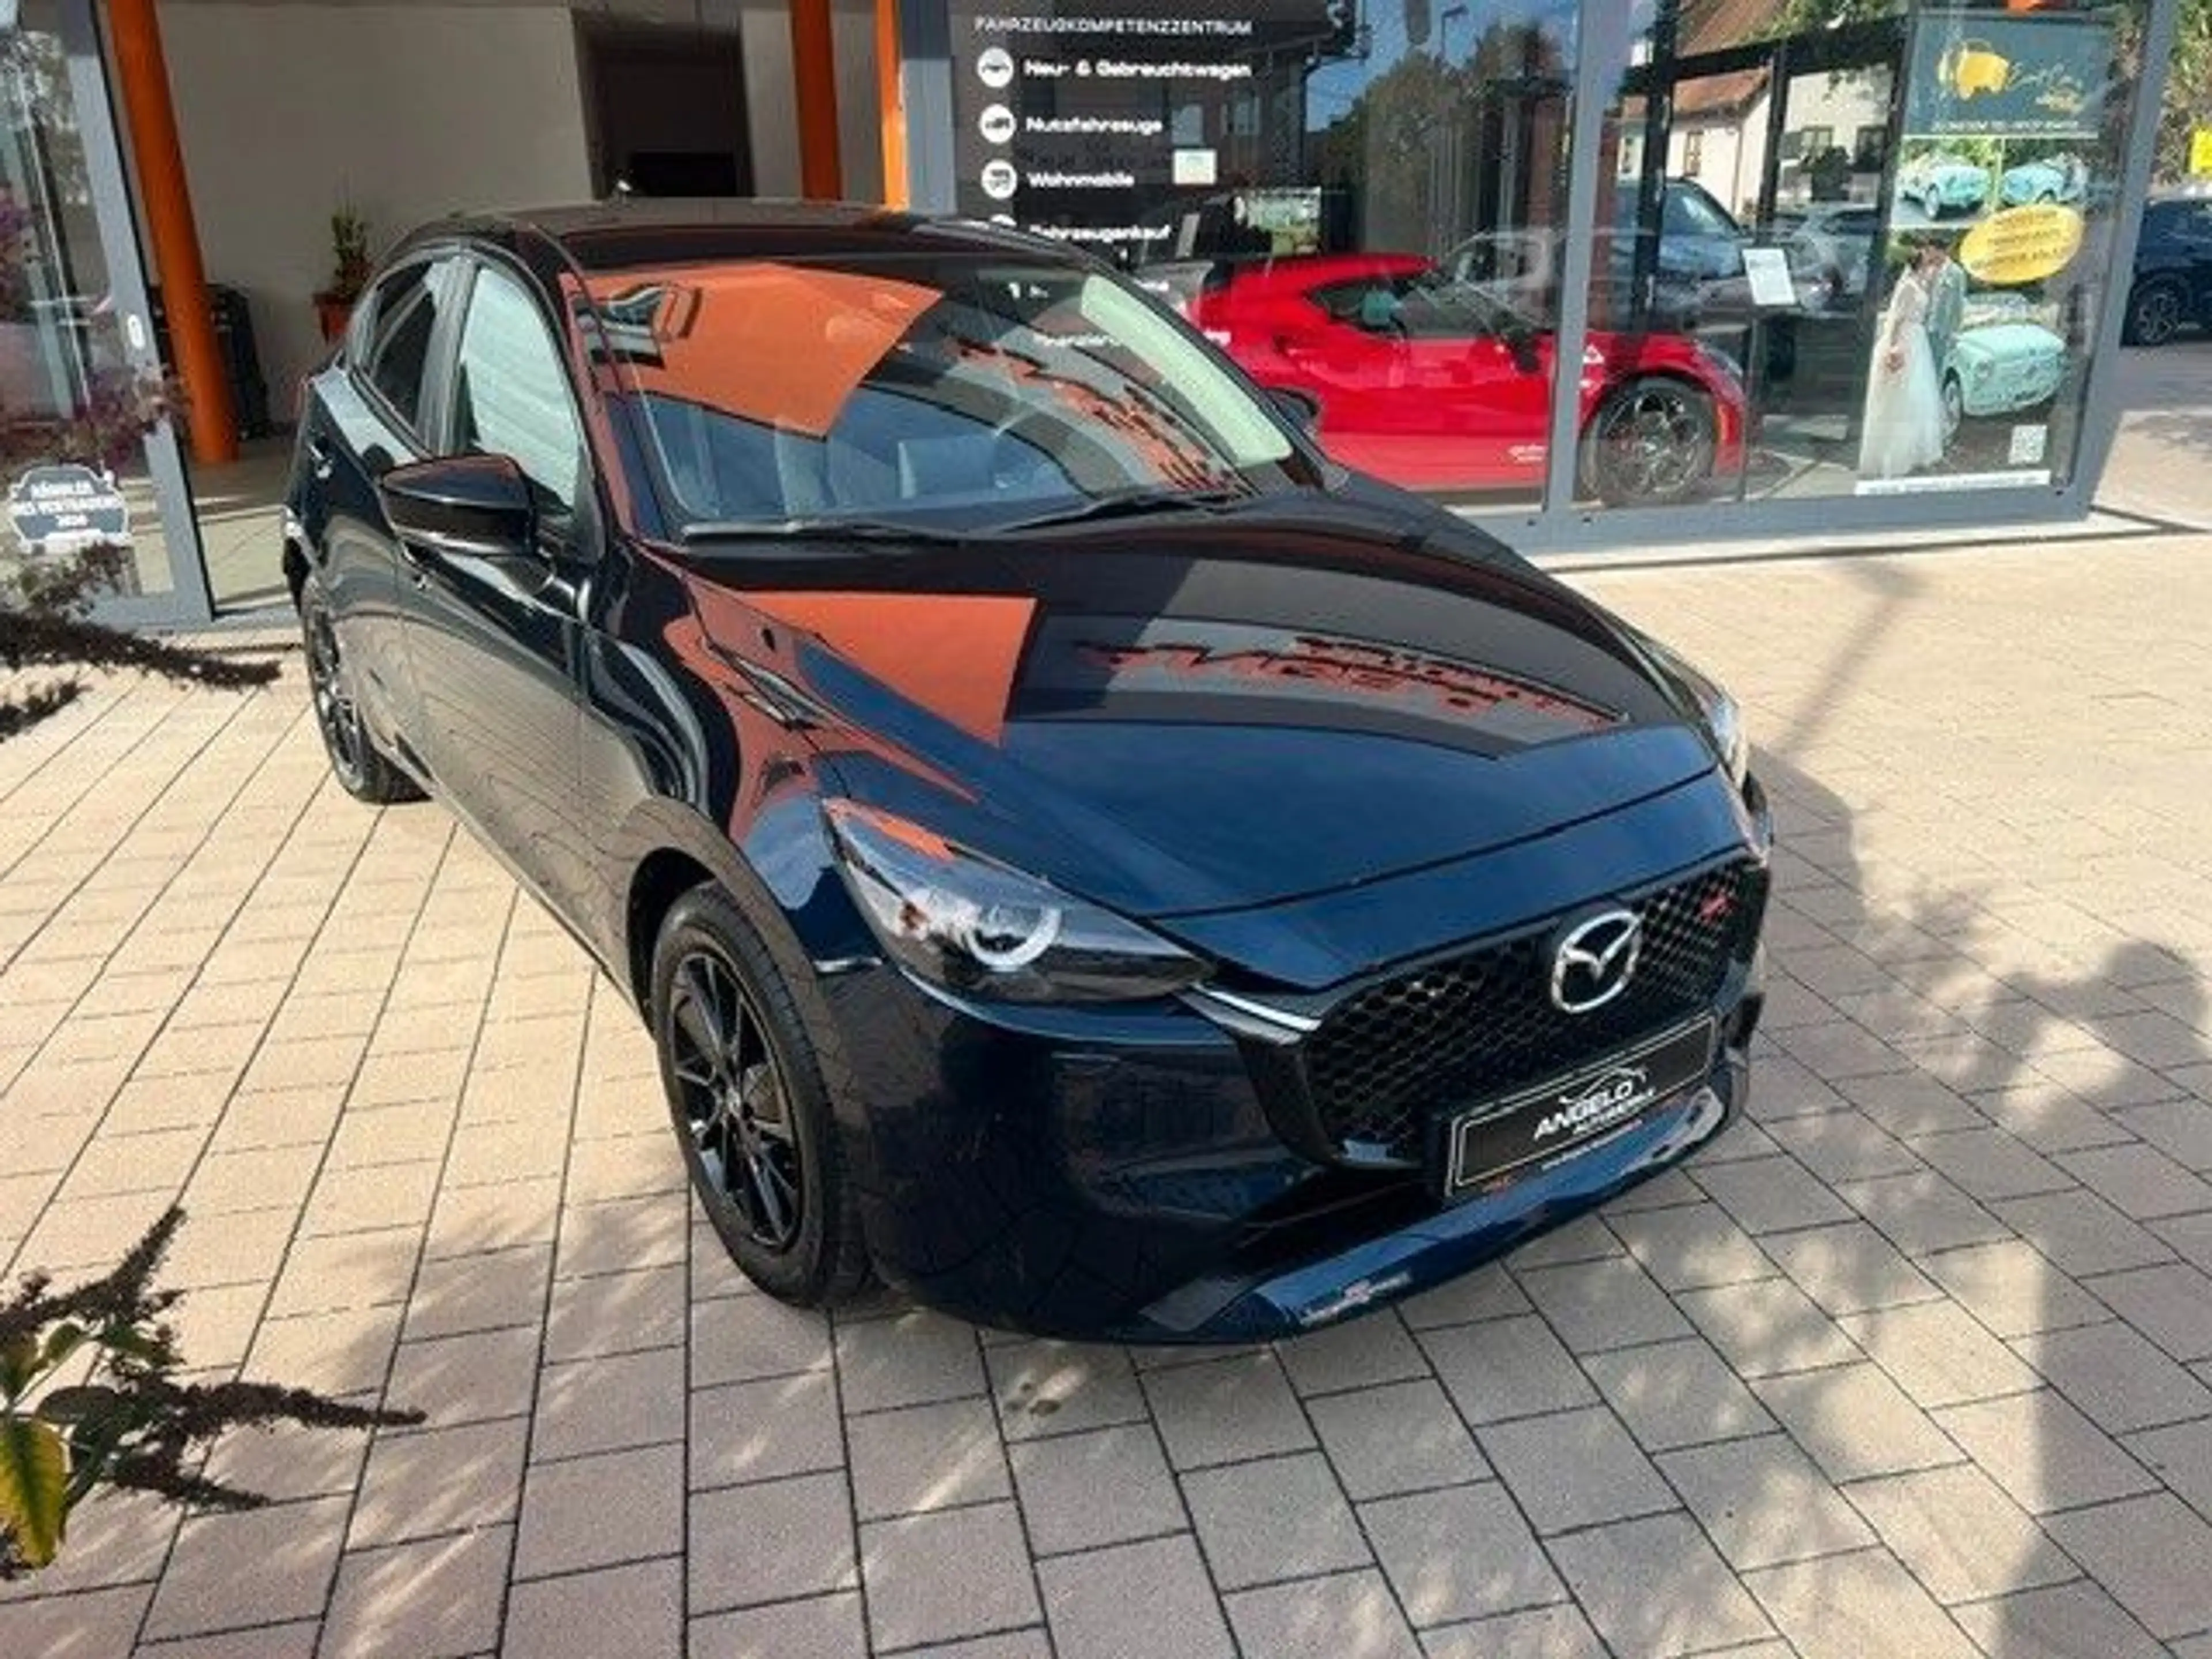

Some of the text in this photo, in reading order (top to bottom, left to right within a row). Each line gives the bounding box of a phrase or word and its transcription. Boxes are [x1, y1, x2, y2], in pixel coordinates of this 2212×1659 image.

[1075, 59, 1092, 77] &
[1096, 59, 1253, 81] Gebrauchtwagen
[1025, 116, 1163, 135] Nutzfahrzeuge
[1027, 172, 1135, 188] Wohnmobile
[1533, 1080, 1634, 1142] ANGELO
